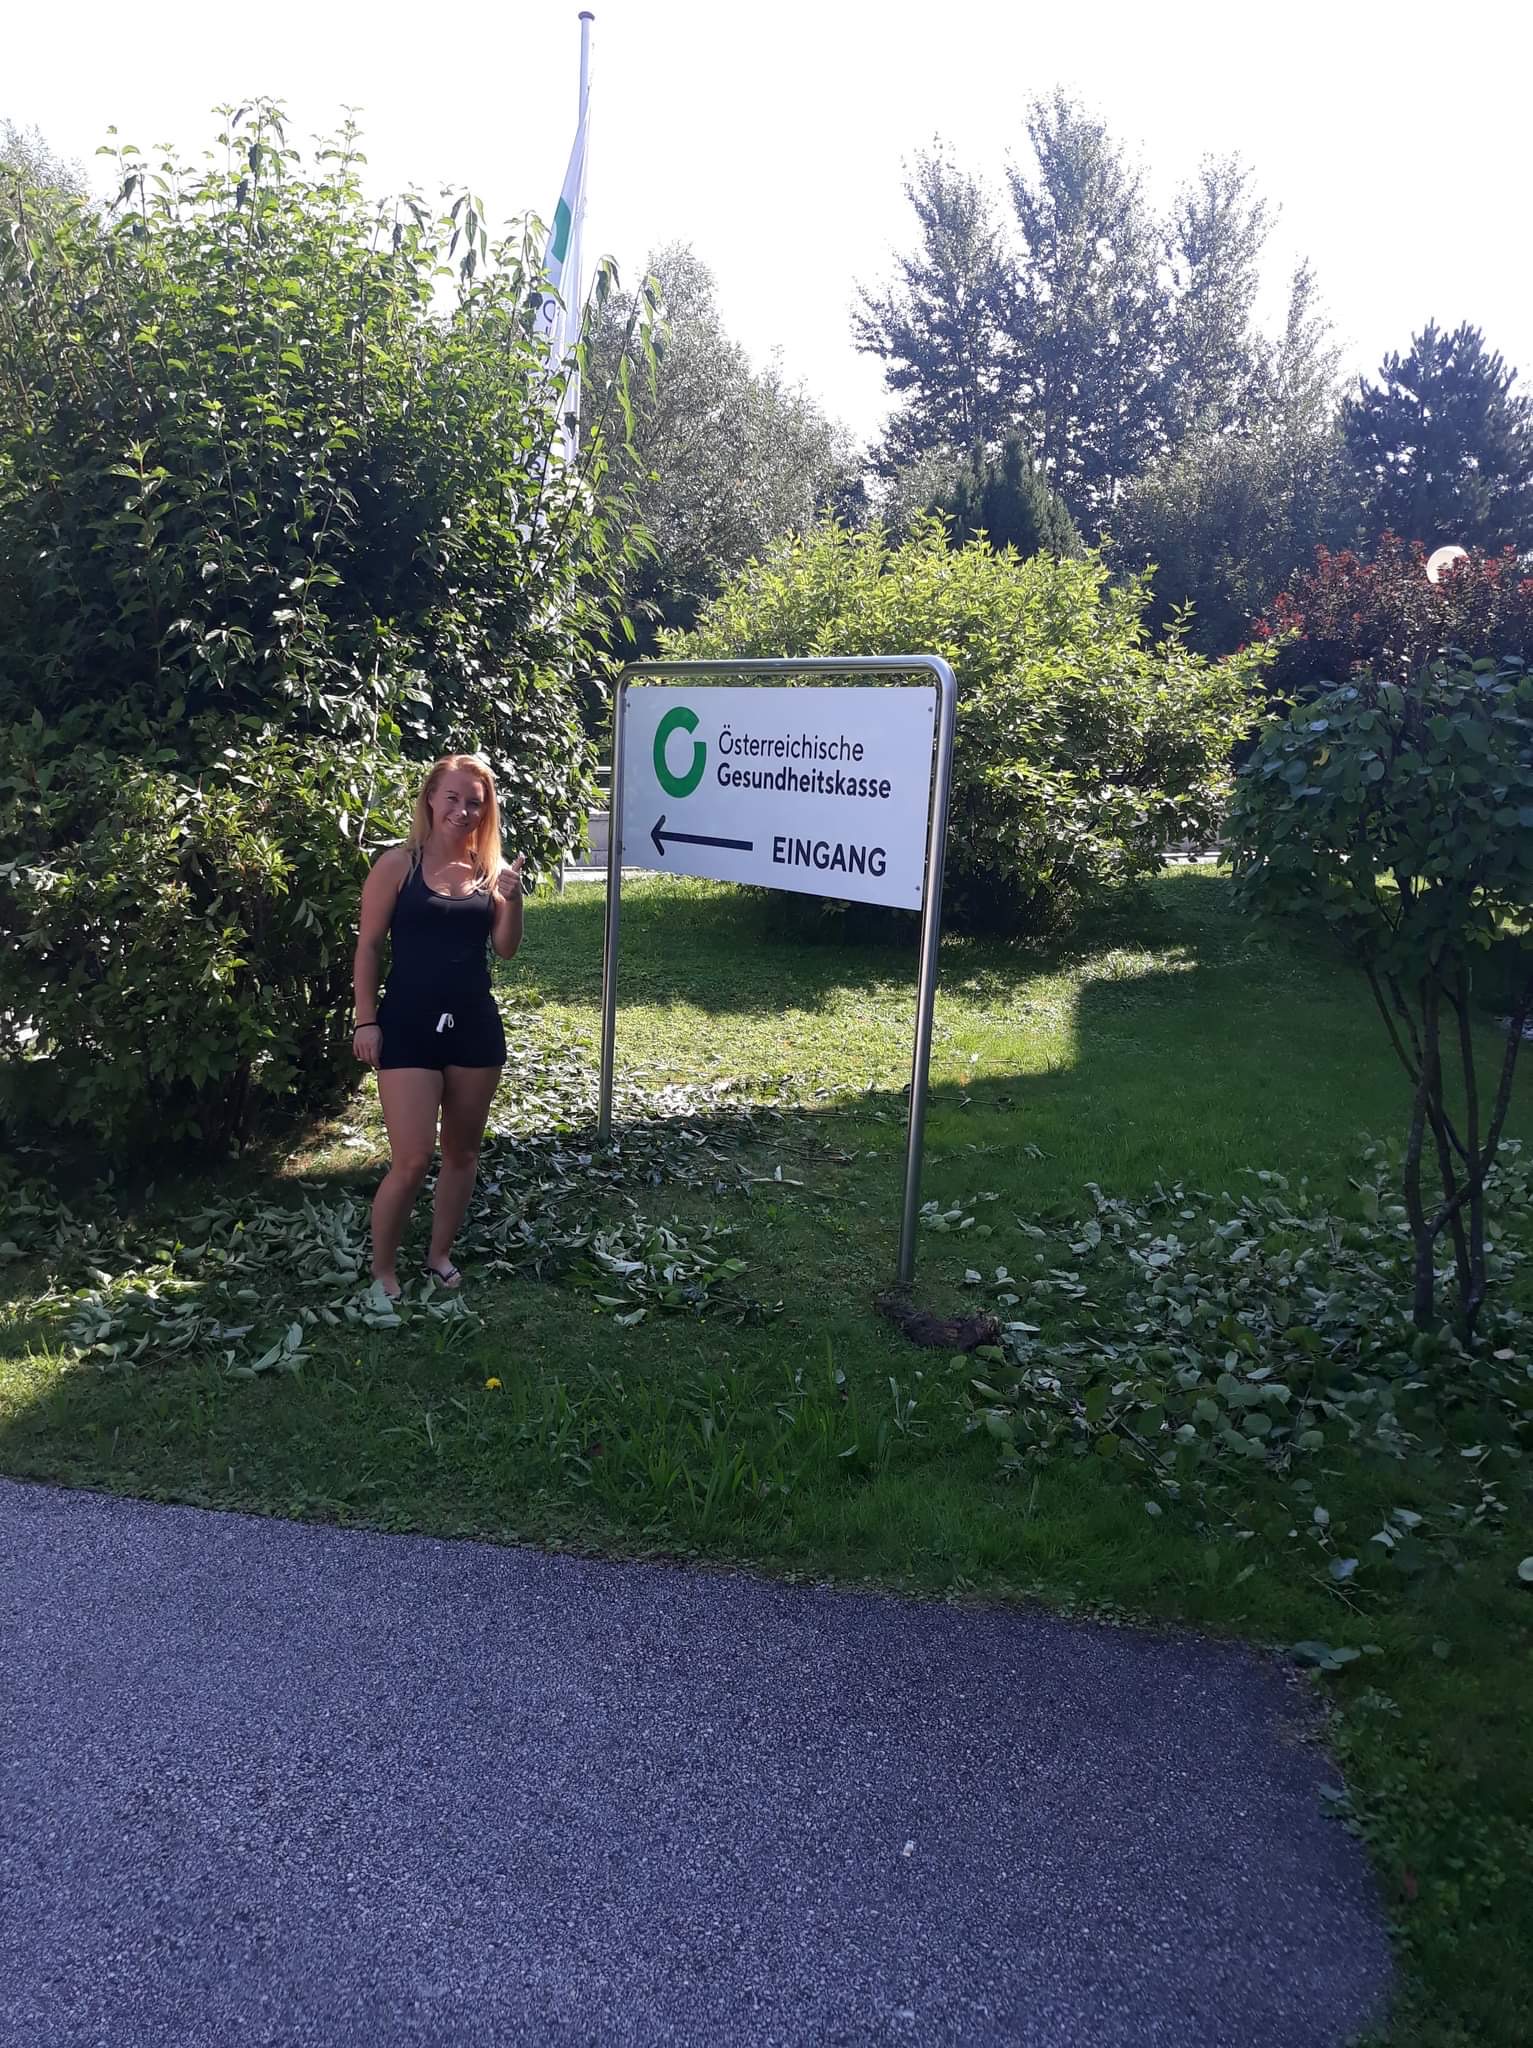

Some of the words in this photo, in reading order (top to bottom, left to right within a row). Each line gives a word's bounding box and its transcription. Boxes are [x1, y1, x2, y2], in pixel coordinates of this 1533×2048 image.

[718, 724, 864, 762] Österreichische
[717, 762, 892, 799] Gesundheitskasse
[773, 835, 887, 877] EINGANG
